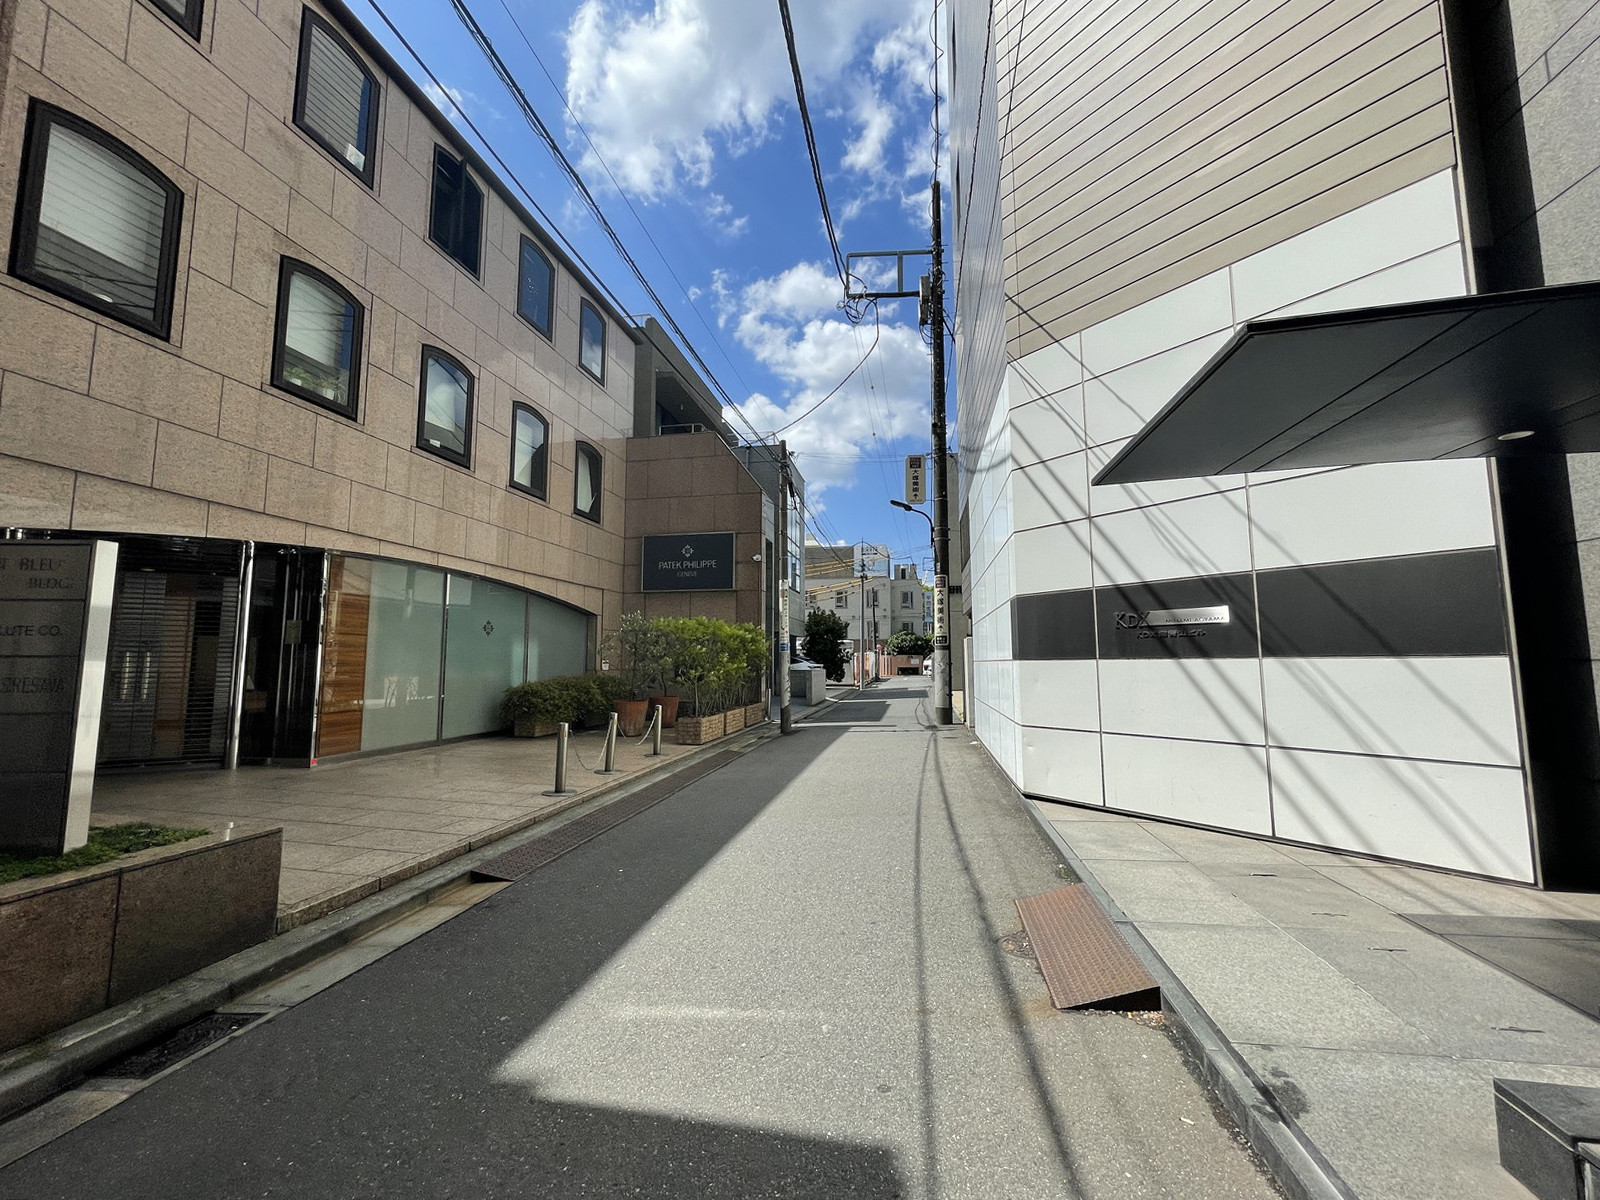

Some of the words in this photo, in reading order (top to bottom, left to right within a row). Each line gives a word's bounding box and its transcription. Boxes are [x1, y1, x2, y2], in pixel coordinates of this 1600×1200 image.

[658, 560, 682, 570] PATEK
[683, 559, 717, 569] PHILIPPE
[1114, 610, 1151, 630] KDX
